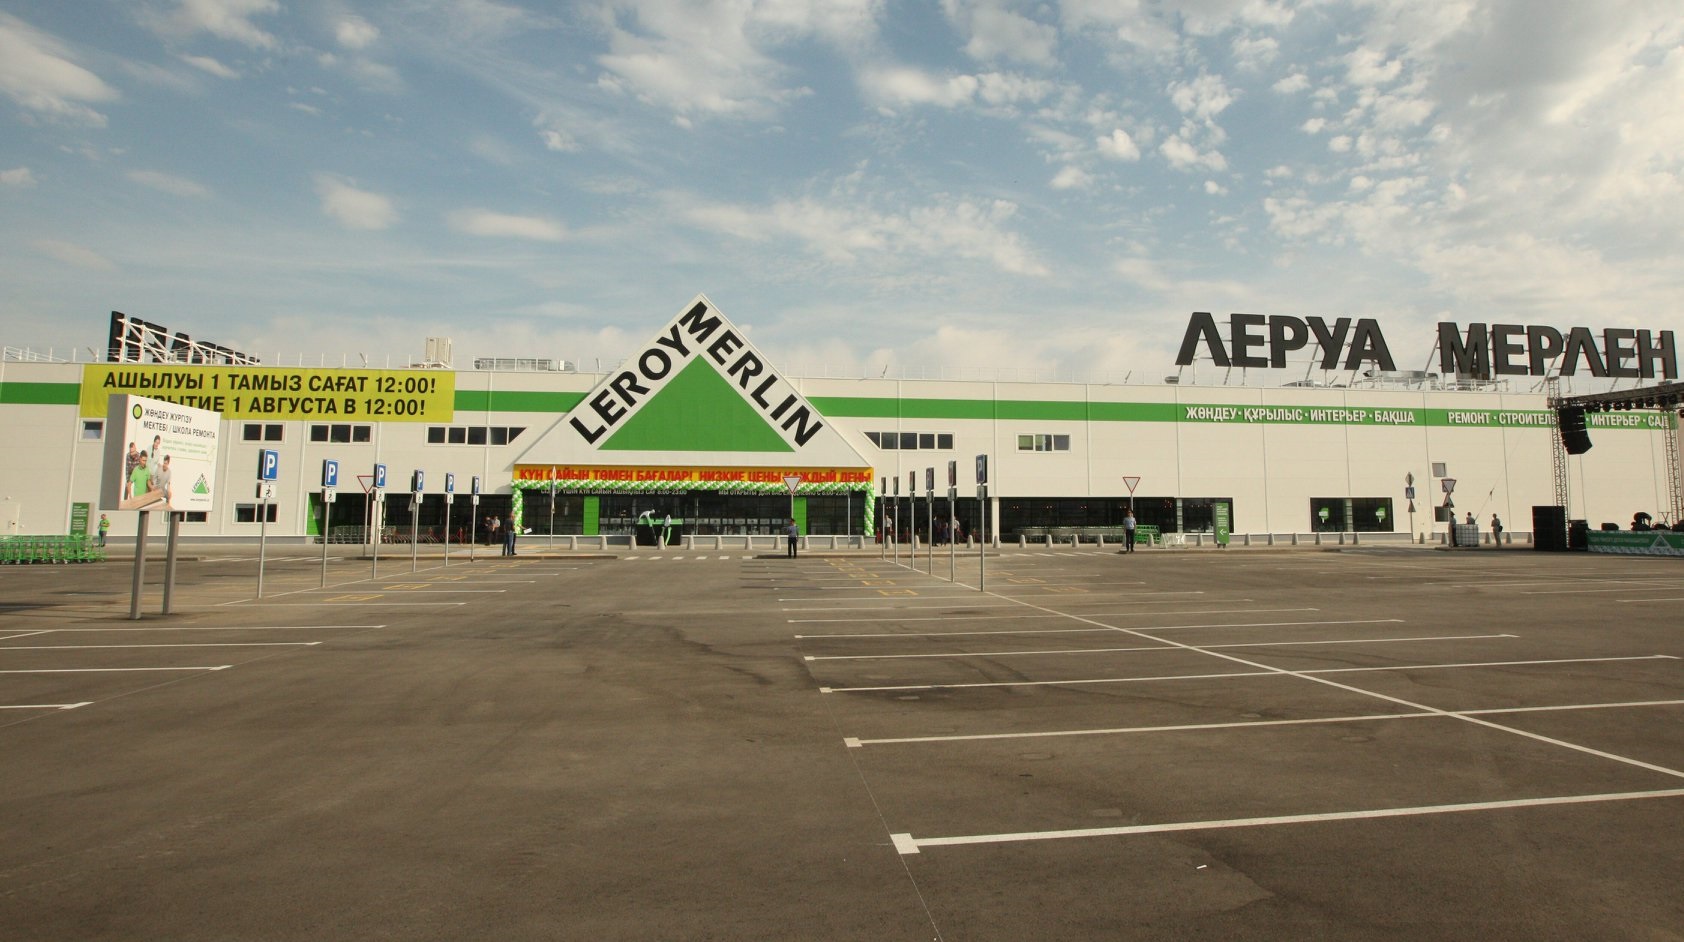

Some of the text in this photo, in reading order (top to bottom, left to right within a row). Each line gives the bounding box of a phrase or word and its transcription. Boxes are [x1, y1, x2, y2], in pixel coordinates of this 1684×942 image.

[1175, 312, 1678, 380] ЛЕРУА МЕРЛЕН
[103, 371, 436, 394] АШЫЛУЫ 1 ТАМЫЗ САҒАТ 12:00!
[569, 301, 824, 447] LEROY MERLIN
[233, 397, 241, 413] 1
[249, 397, 337, 414] АВГУСТА
[344, 398, 356, 414] В
[365, 399, 425, 416] 12:00!
[1186, 406, 1237, 421] ЖӨНДЕУ
[1310, 409, 1366, 422] ИНТЕРЬЕР
[1374, 410, 1415, 425] БАҚША
[1448, 411, 1490, 424] РЕМОНТ
[1591, 414, 1640, 427] ИНТЕРЬЕР
[172, 425, 192, 436] ШКОЛА
[192, 428, 216, 439] РЕМОНТА
[266, 454, 276, 476] P
[328, 463, 336, 482] P
[378, 467, 385, 484] P
[699, 471, 744, 482] НИЗКИЕ
[748, 471, 781, 483] ЦЕНЫ
